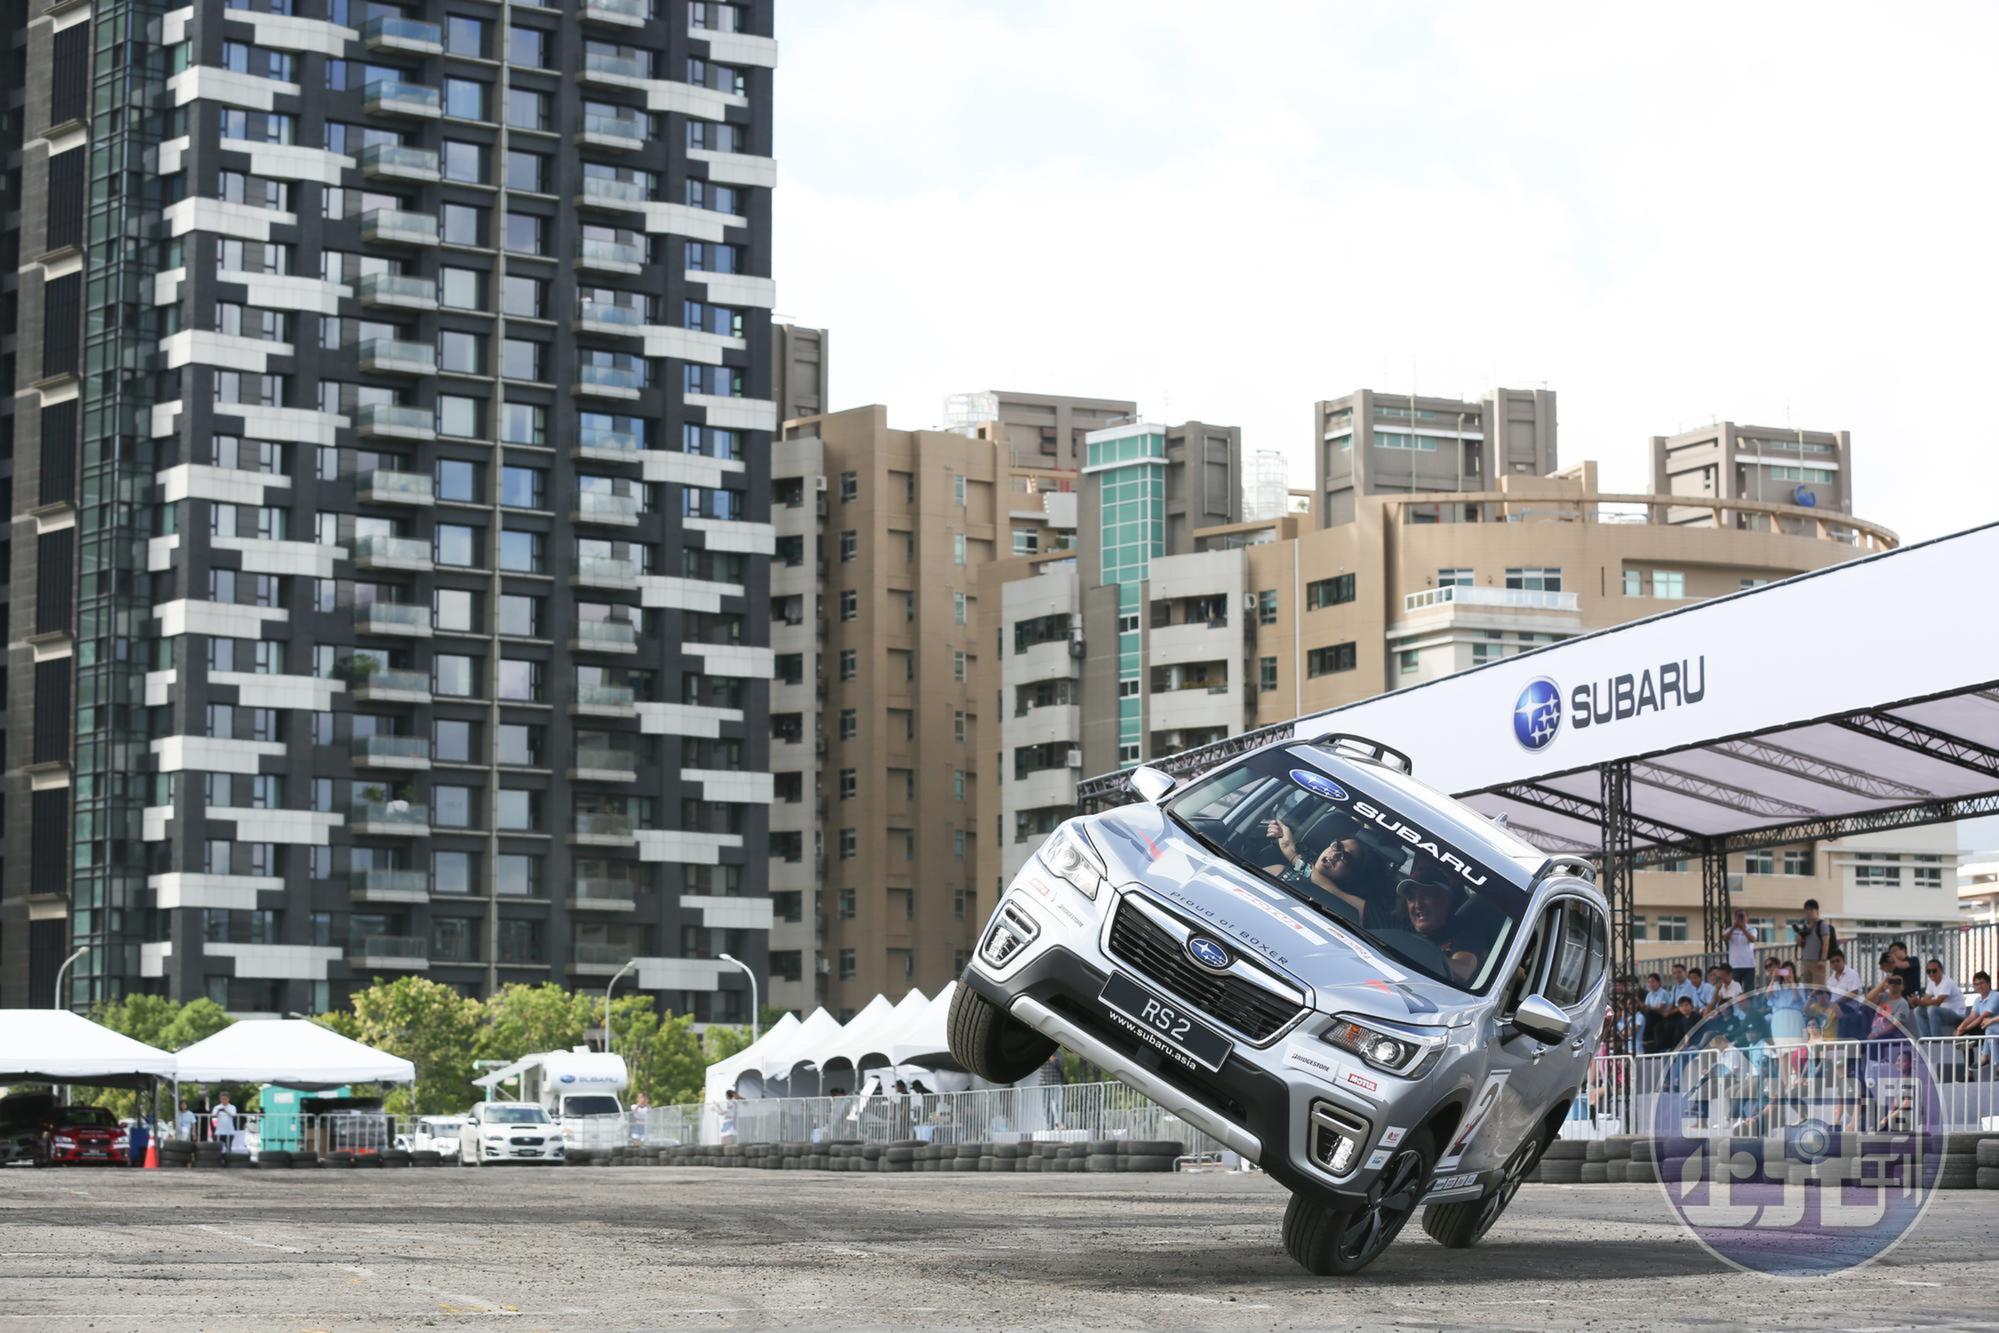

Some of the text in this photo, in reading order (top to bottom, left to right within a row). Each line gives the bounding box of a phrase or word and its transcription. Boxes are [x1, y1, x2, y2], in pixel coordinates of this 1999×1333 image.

[1571, 655, 1705, 730] SUBARU
[1352, 801, 1487, 886] SUBARU
[1239, 930, 1288, 965] BOXER
[1109, 1010, 1197, 1070] www.subaru.asia
[1291, 1052, 1330, 1072] BRIDGESTONE
[1349, 1074, 1377, 1091] MOTUL
